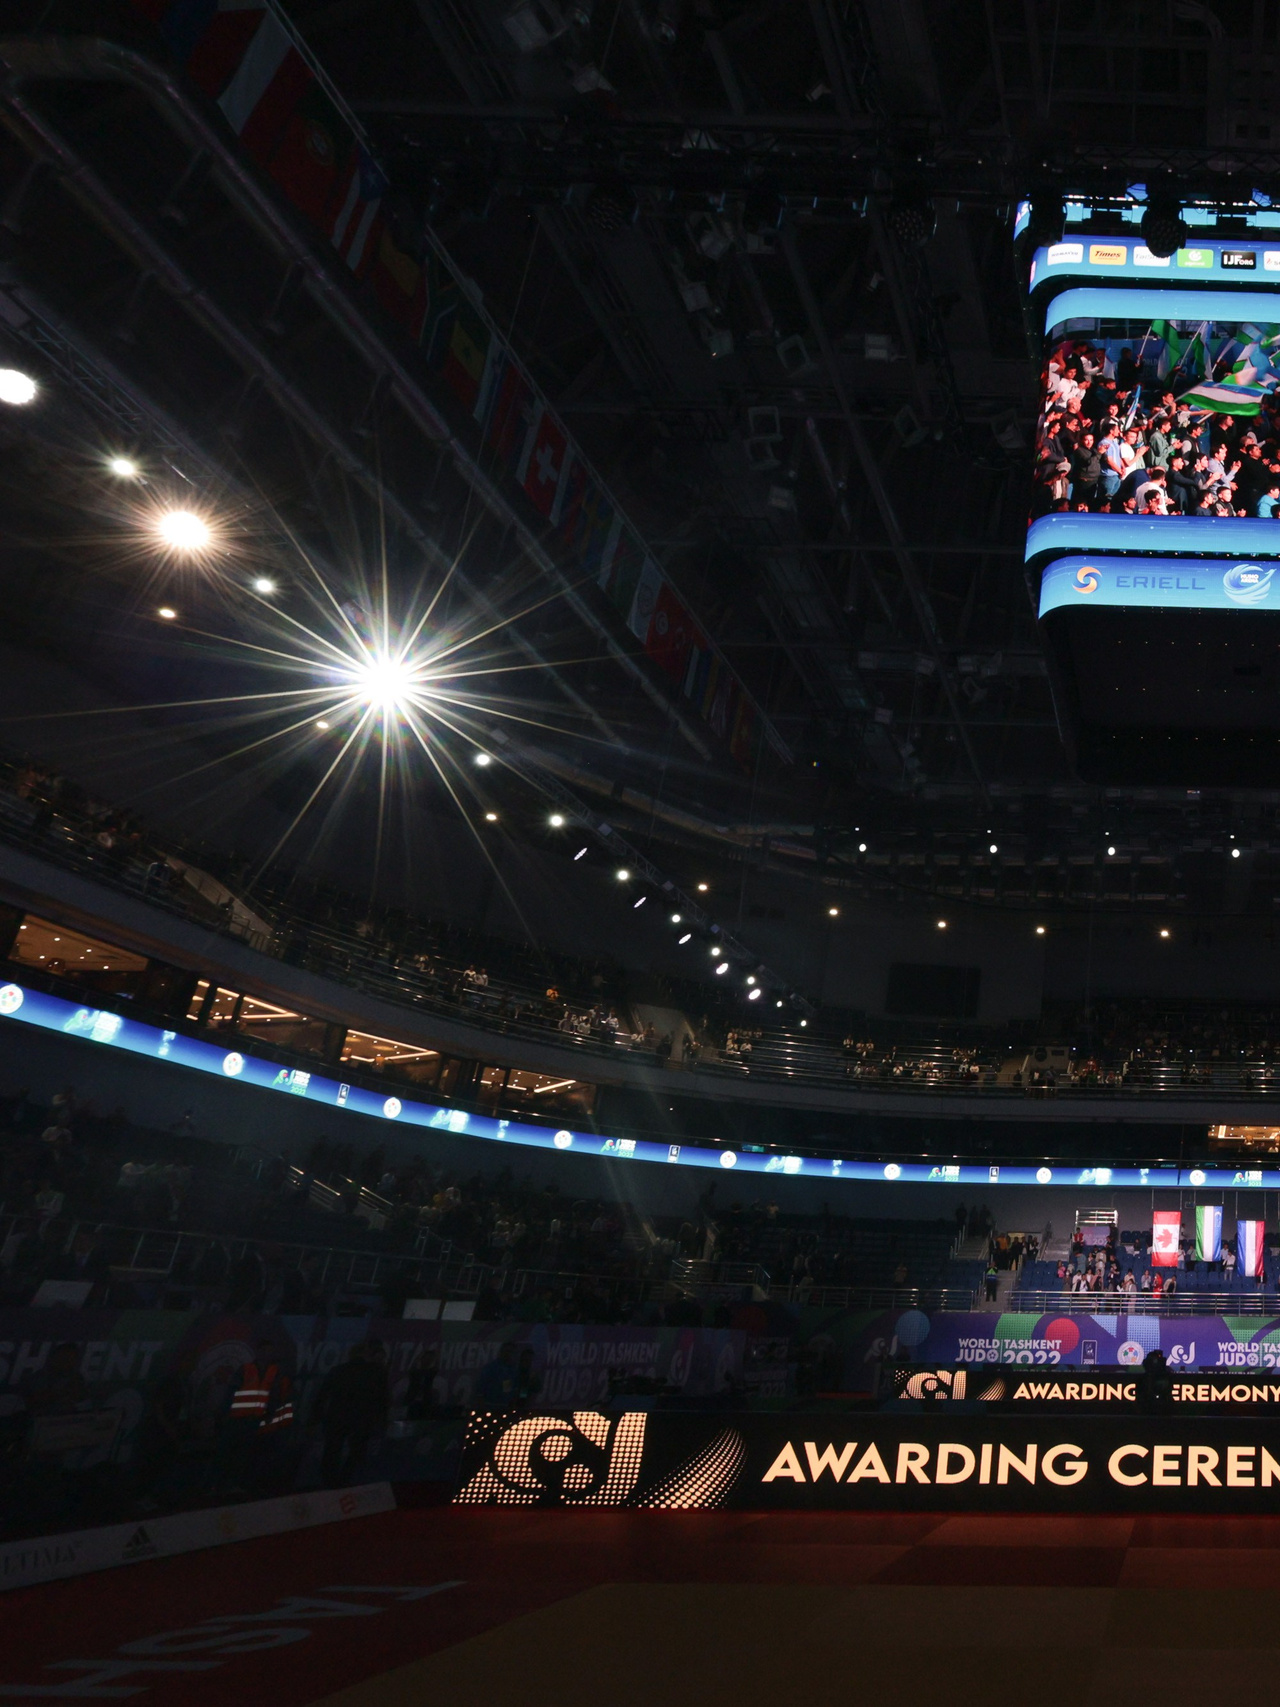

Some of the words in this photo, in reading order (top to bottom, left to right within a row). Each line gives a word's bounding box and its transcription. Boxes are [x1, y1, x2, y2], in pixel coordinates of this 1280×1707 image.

[1095, 250, 1122, 258] Times
[1115, 575, 1206, 590] ERIELL
[958, 1338, 999, 1350] WORLD
[1004, 1338, 1062, 1350] TASHKENT
[1217, 1341, 1259, 1353] WORLD
[955, 1349, 999, 1363] JUDO
[1004, 1350, 1061, 1364] 2022
[1216, 1352, 1259, 1366] JUDO
[1013, 1383, 1136, 1402] AWARDING
[761, 1441, 1089, 1486] AWARDING
